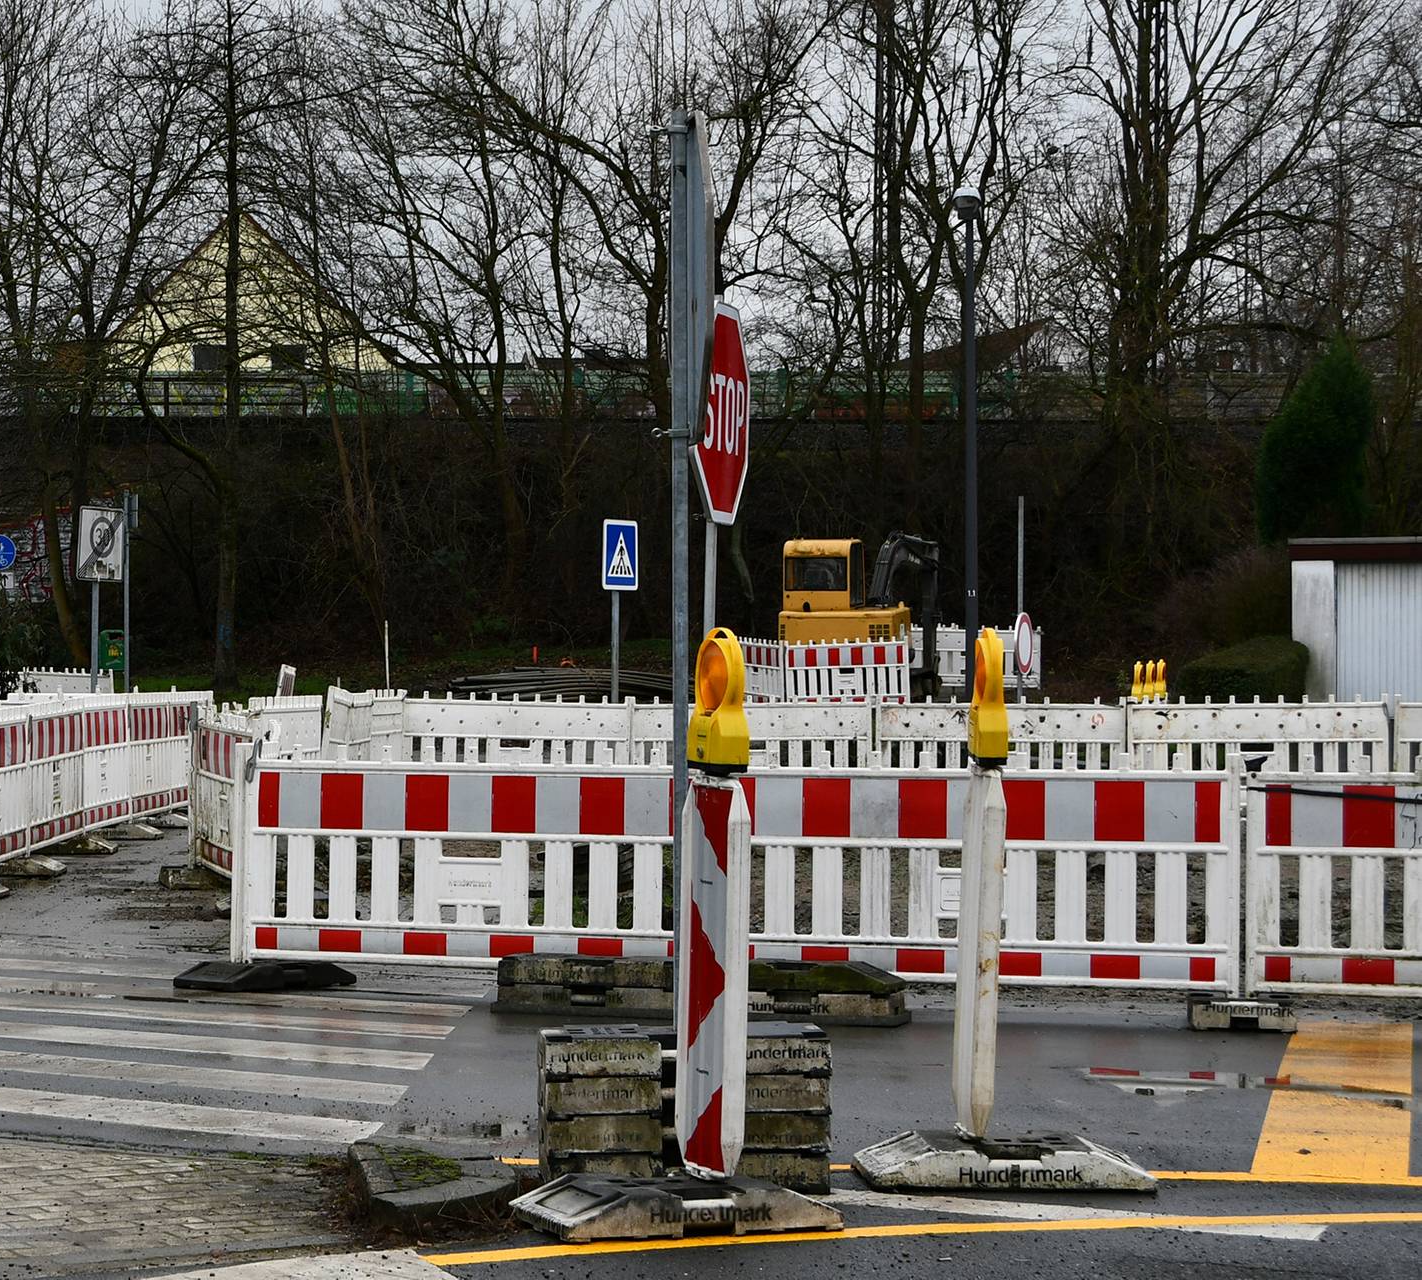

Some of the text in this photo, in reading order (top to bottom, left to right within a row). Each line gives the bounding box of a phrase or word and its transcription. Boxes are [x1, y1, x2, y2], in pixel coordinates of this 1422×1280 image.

[704, 372, 746, 456] STOP
[95, 528, 110, 546] 30
[746, 1045, 829, 1060] undertmark
[959, 1165, 1084, 1183] Hundertmark
